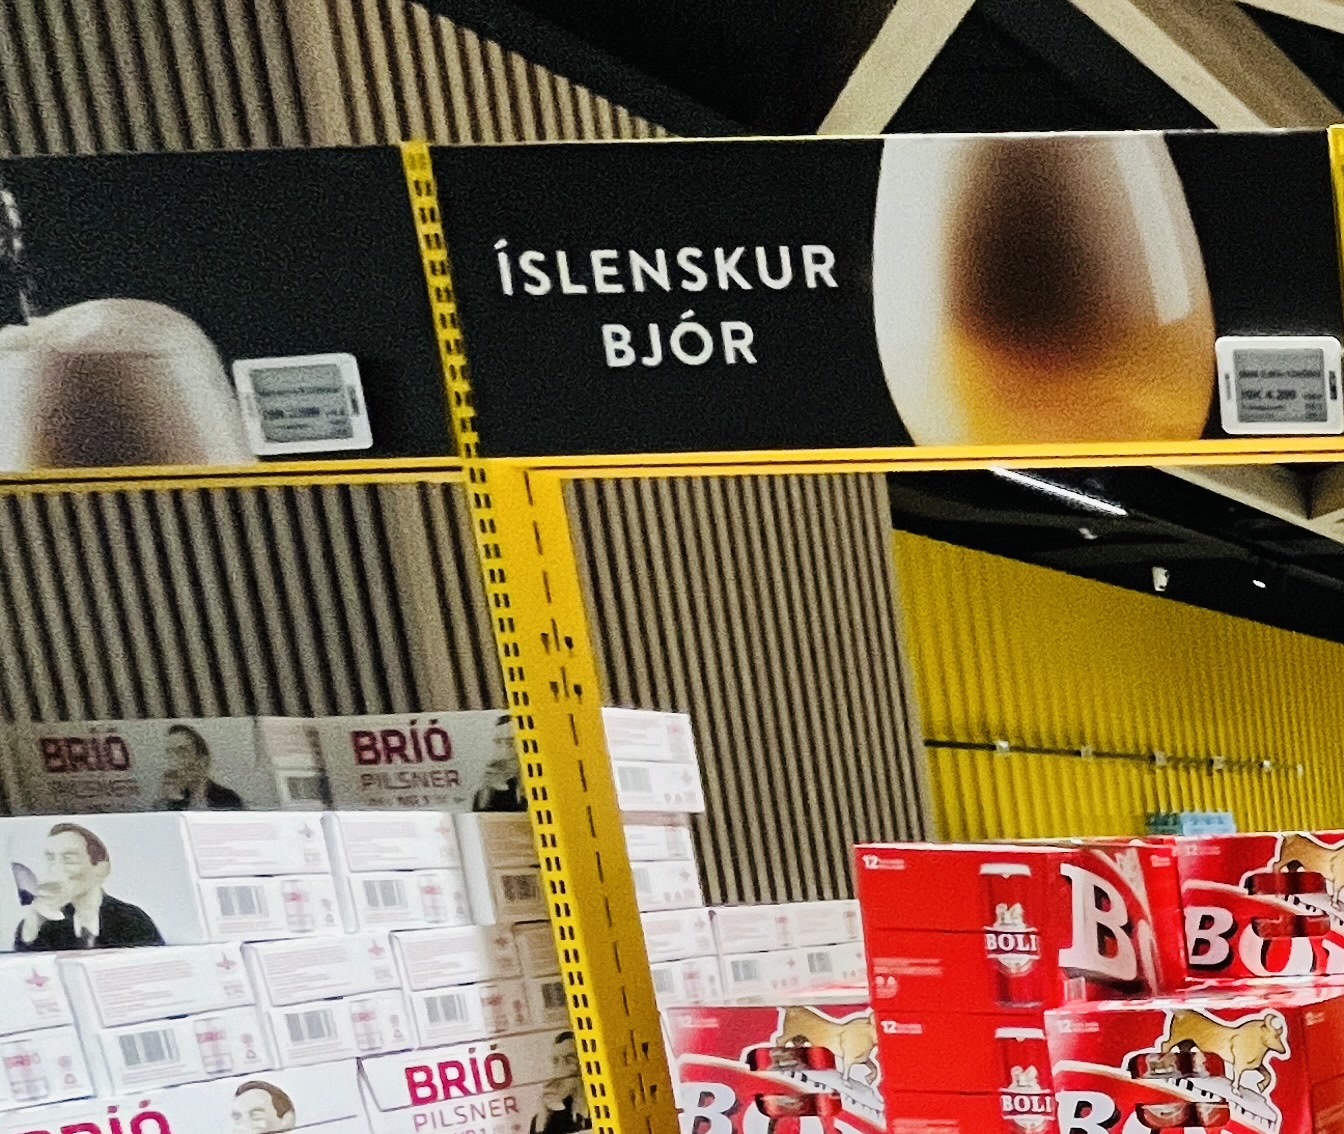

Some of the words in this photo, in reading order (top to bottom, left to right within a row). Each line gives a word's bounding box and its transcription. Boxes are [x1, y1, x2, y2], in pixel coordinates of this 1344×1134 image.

[494, 239, 839, 296] ÍSLENSKUR
[602, 309, 757, 368] BJÓR
[350, 719, 453, 766] BRÍÓ
[985, 931, 1038, 955] BOLI
[404, 1043, 513, 1107] BRÍÓ
[412, 1095, 519, 1133] PILSNER
[1001, 1093, 1053, 1114] BOLI
